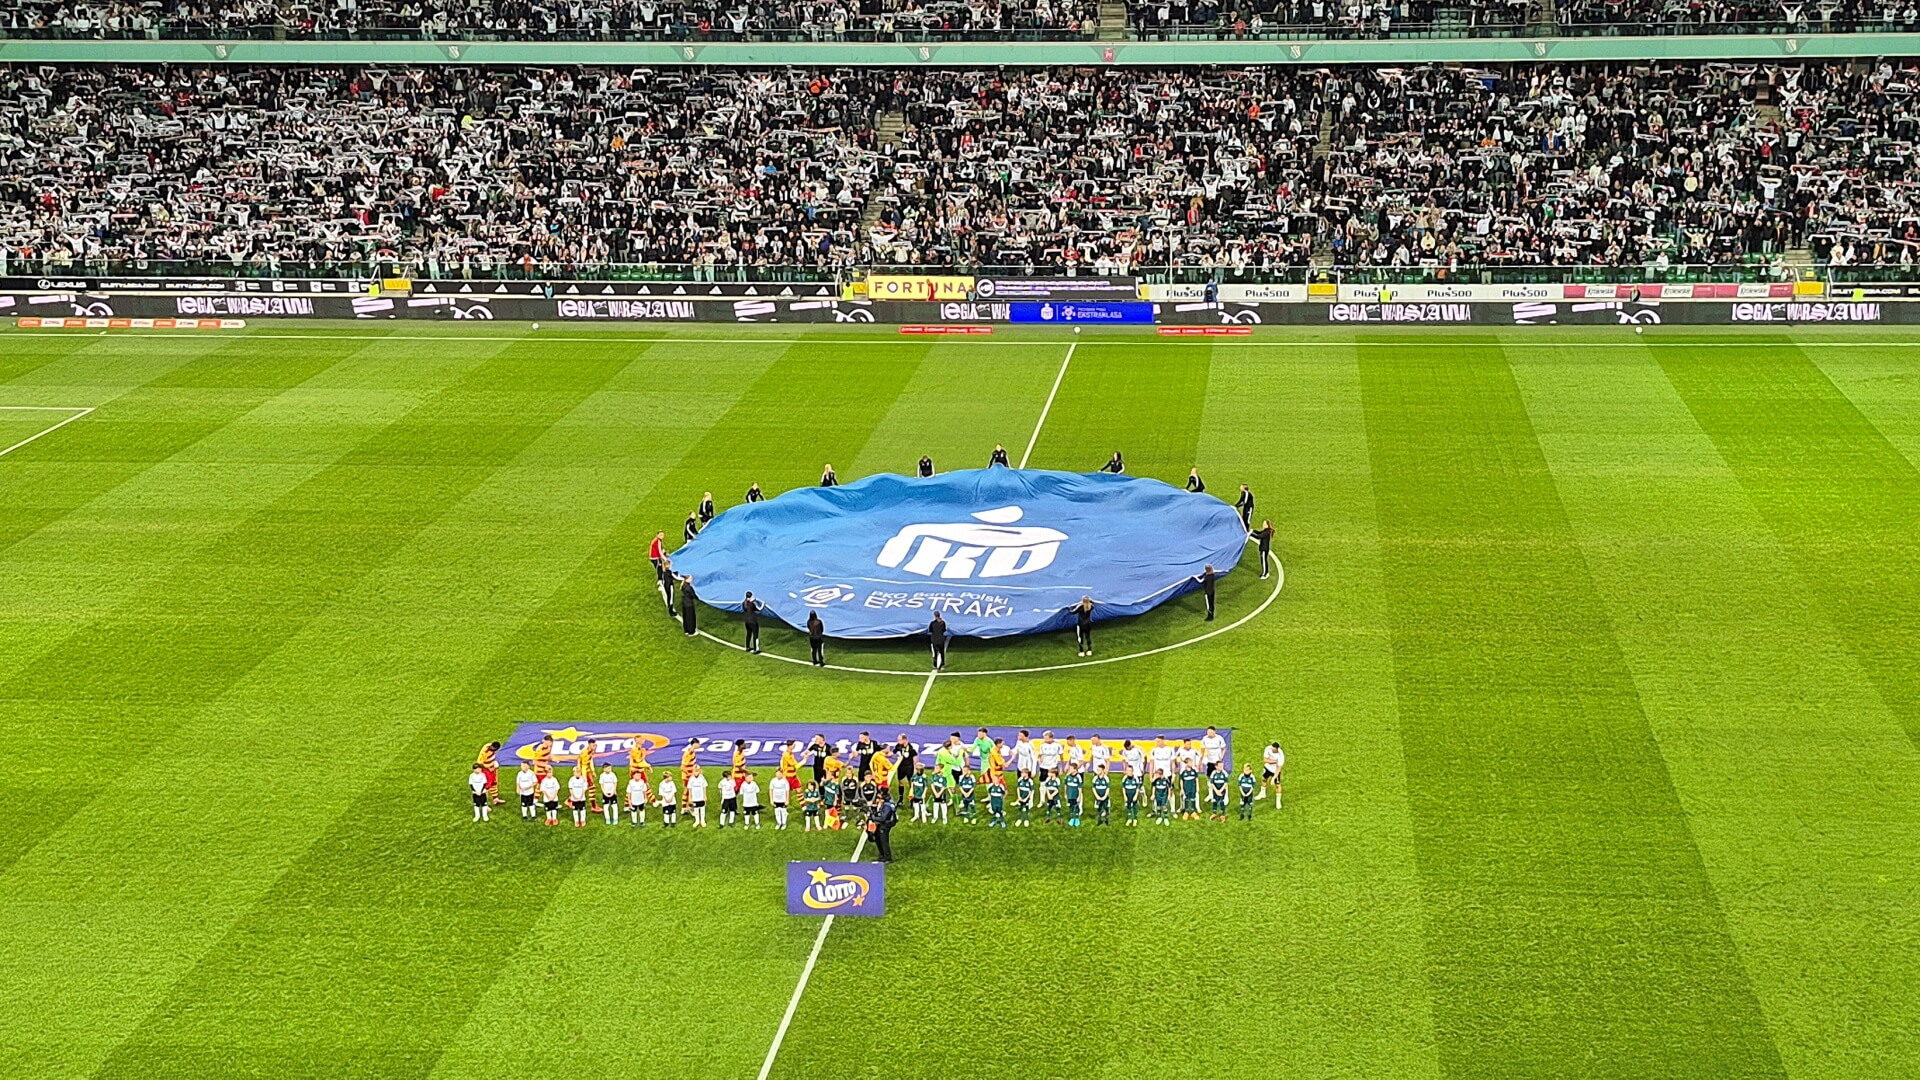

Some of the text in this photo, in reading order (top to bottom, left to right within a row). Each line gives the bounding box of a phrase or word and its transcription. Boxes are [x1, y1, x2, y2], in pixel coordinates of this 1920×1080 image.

[1166, 289, 1205, 297] Plus50
[1245, 289, 1290, 297] Plus500
[1353, 289, 1399, 297] Plus0
[1427, 289, 1472, 297] Plus500
[1502, 289, 1548, 297] Plus500
[871, 590, 908, 599] PKO
[960, 591, 1009, 605] Polski
[816, 881, 857, 902] LOTTO
